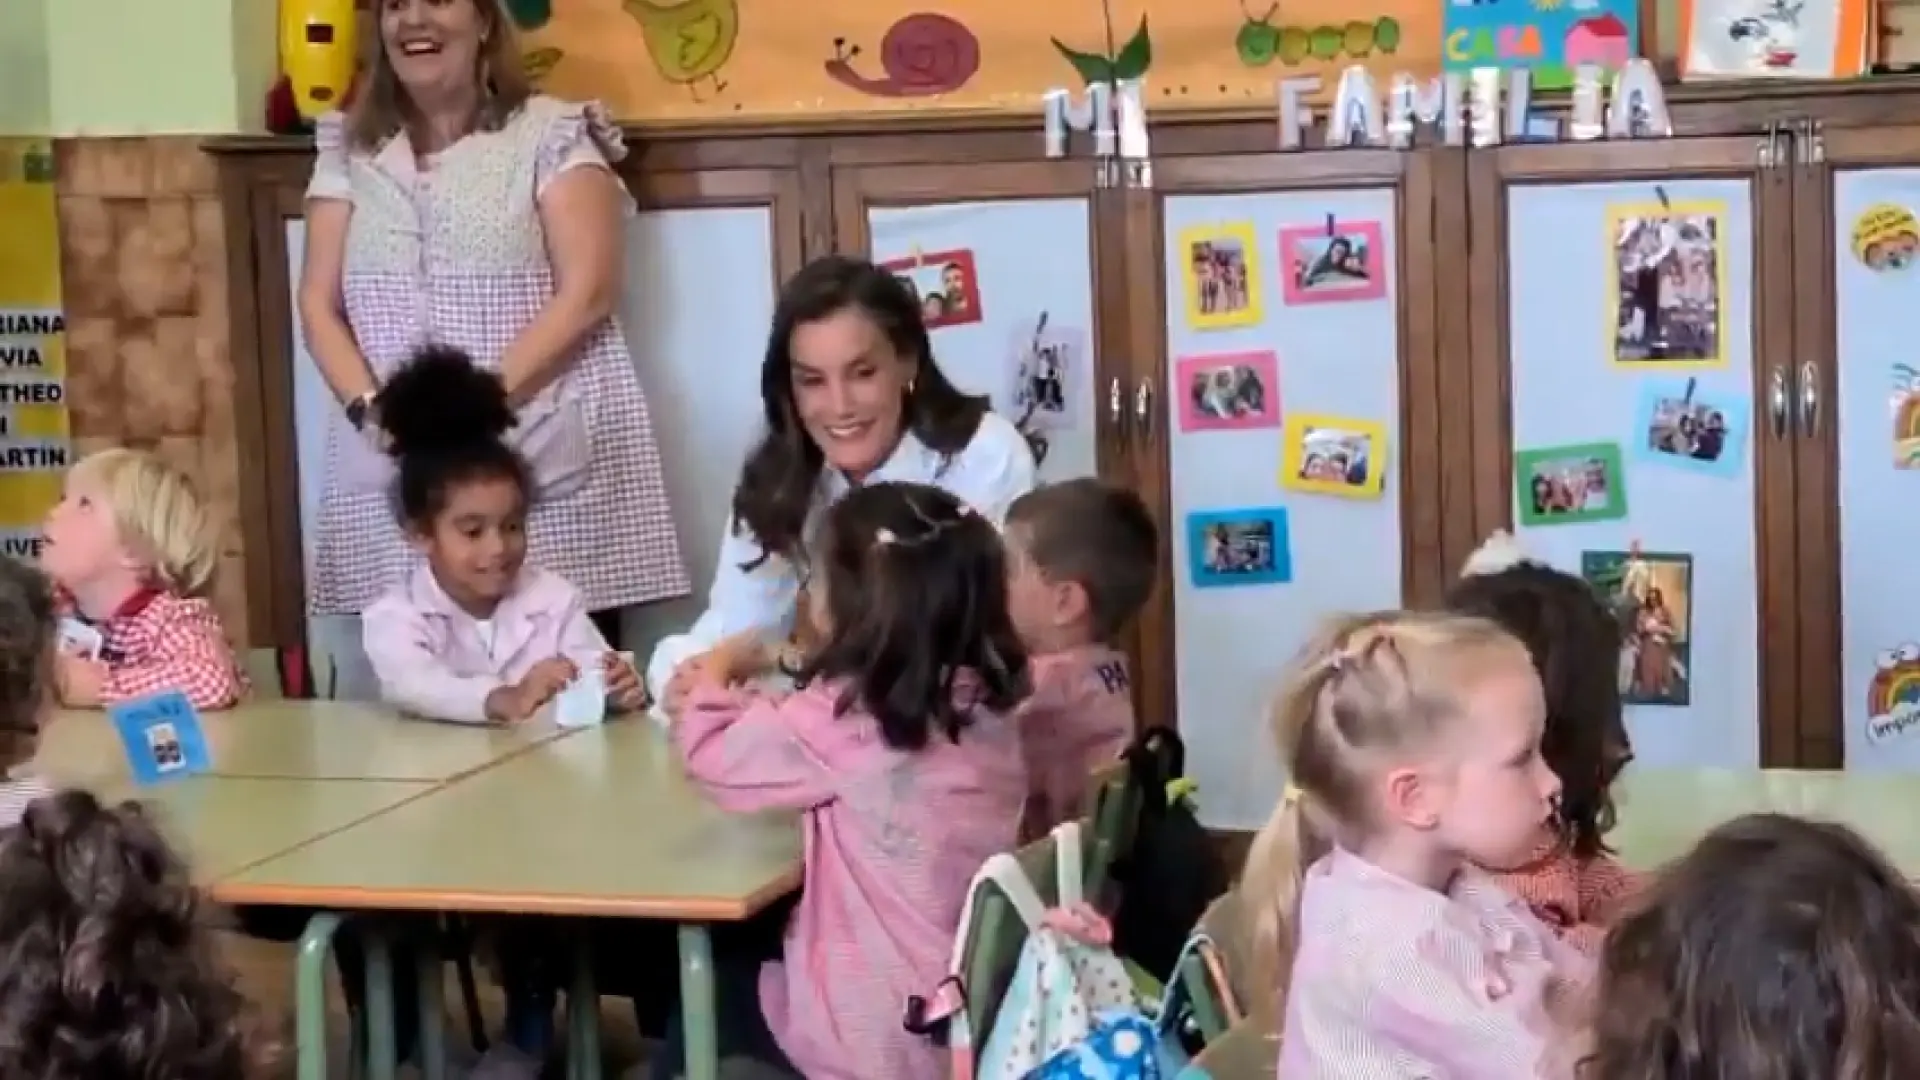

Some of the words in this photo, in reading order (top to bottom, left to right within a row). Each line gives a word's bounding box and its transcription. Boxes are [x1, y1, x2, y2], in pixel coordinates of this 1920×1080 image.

[1445, 24, 1541, 62] CASA
[1042, 78, 1150, 158] MI
[1278, 57, 1672, 150] FAMILIA
